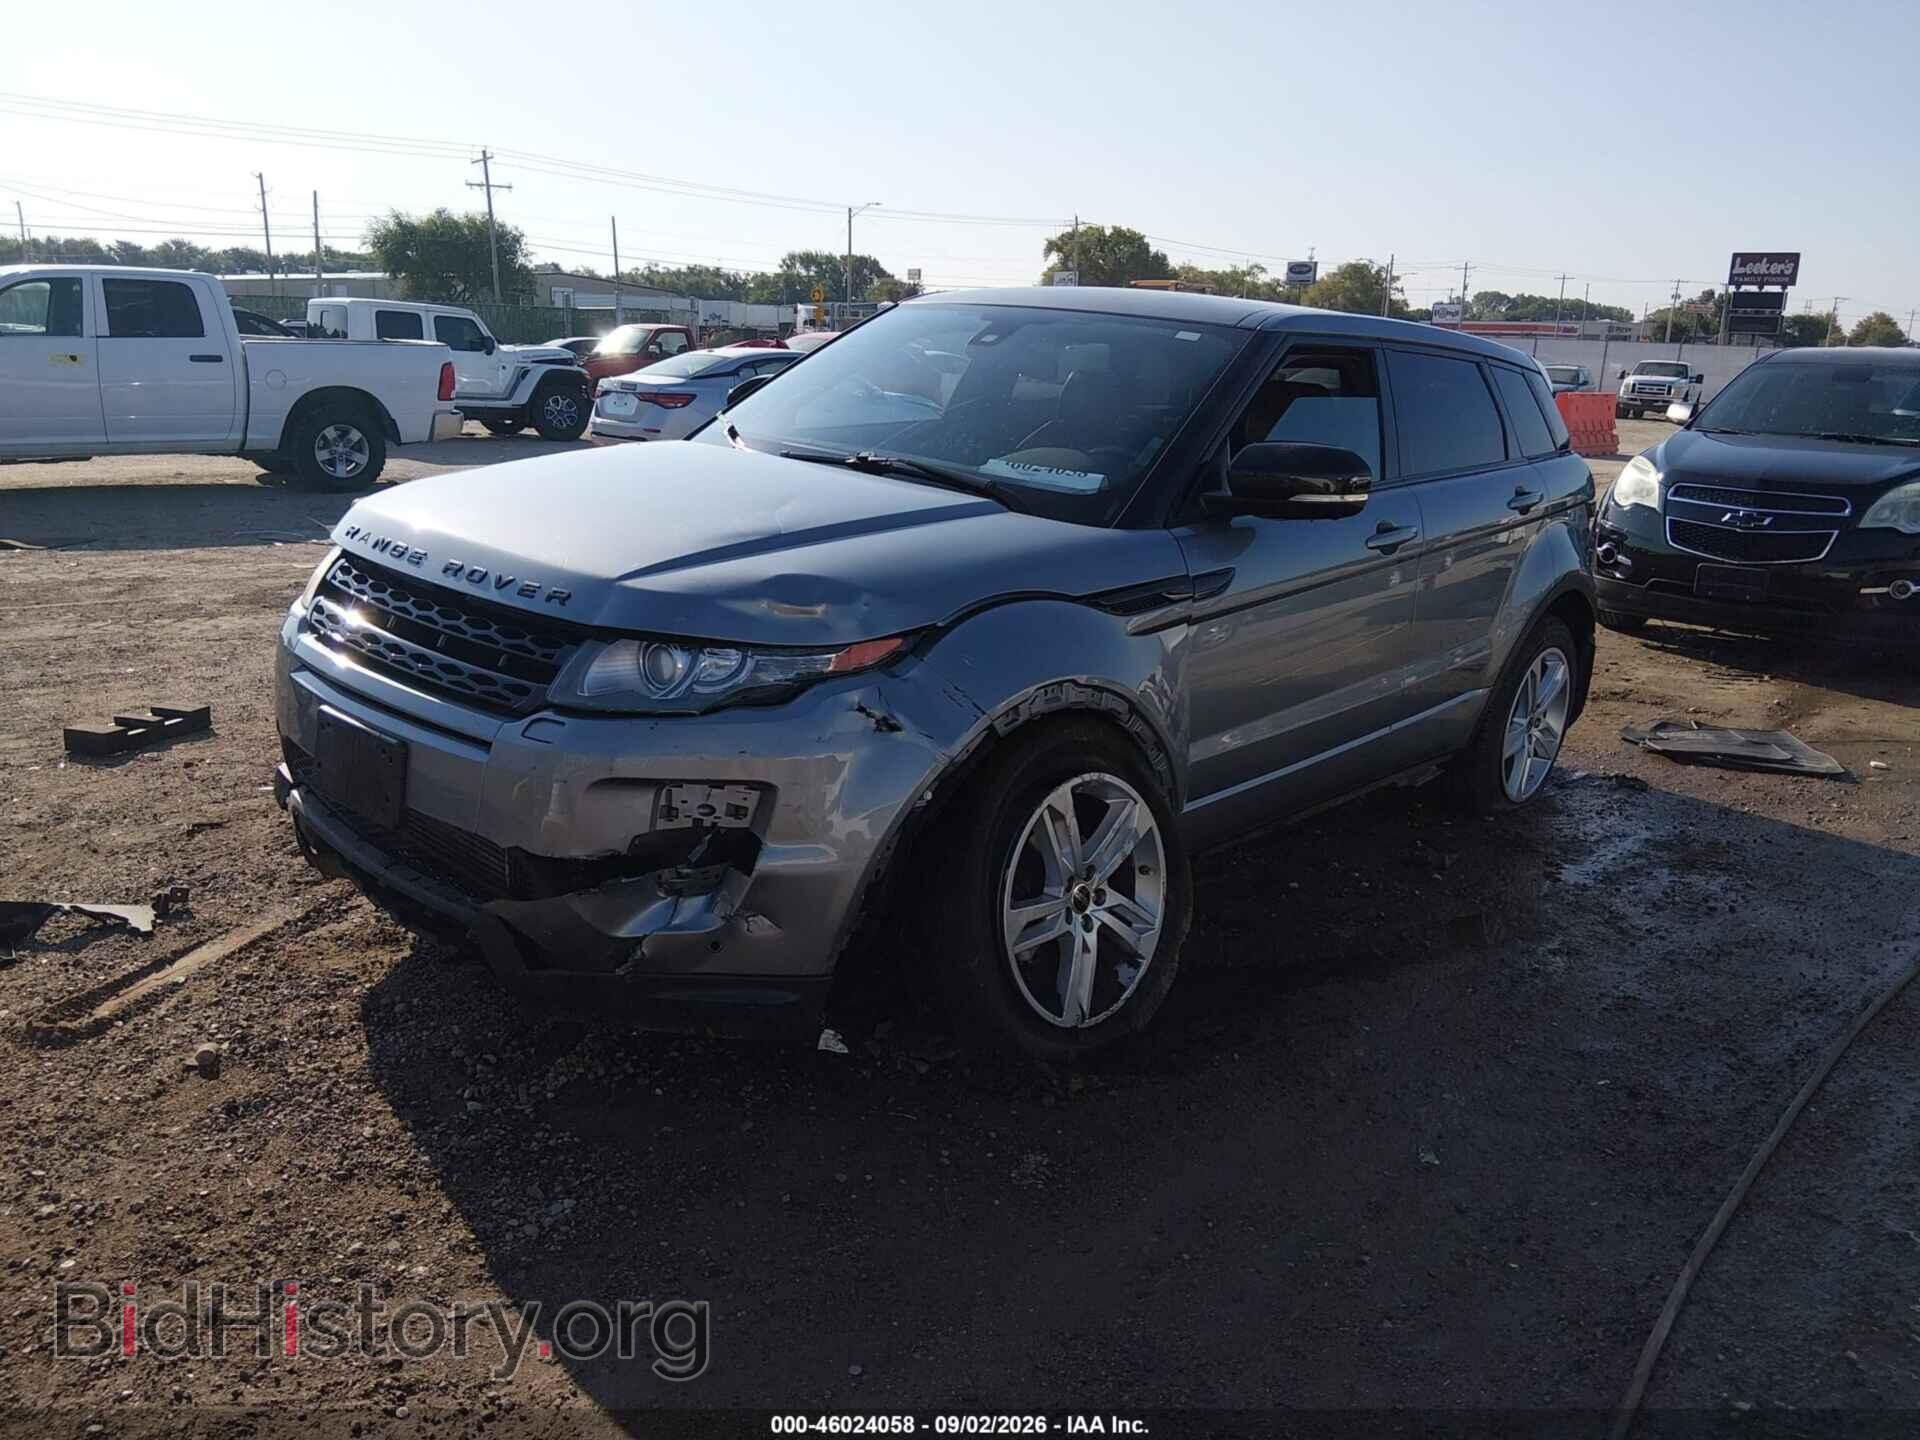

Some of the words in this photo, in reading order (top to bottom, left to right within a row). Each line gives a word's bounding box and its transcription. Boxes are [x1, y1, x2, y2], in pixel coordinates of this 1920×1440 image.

[1733, 257, 1795, 275] Leeker's
[345, 525, 428, 568] RANGE
[441, 558, 573, 607] ROVER
